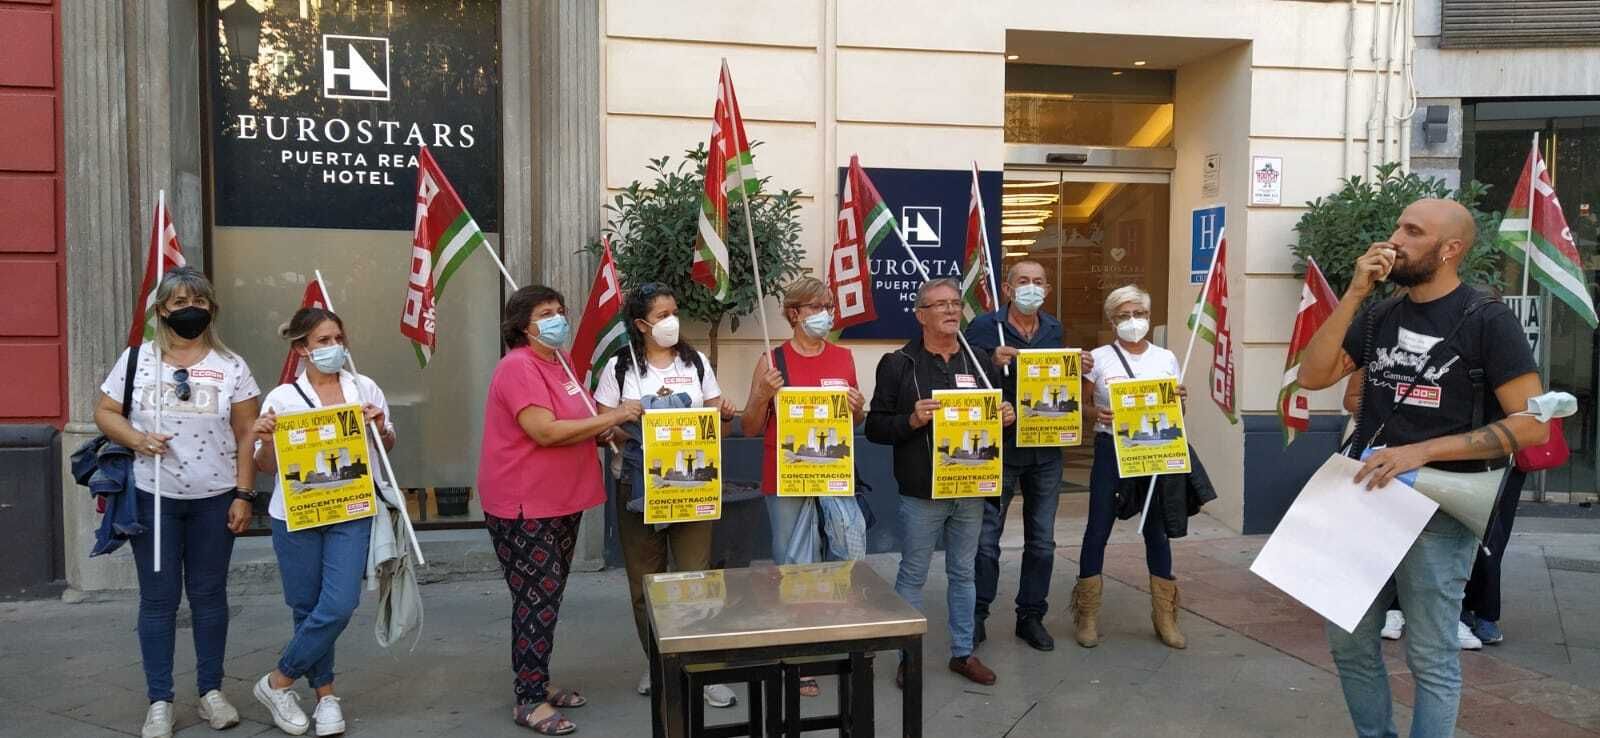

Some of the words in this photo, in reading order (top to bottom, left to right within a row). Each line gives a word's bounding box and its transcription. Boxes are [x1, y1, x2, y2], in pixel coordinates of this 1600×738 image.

[237, 115, 475, 148] EUROSTARS
[282, 150, 368, 166] PUERTA
[378, 154, 420, 168] REA
[323, 170, 394, 185] HOTEL
[1200, 214, 1216, 249] H
[870, 259, 961, 275] UROSTA
[1062, 355, 1078, 377] YA
[1159, 382, 1177, 404] YA
[831, 394, 848, 418] YA
[984, 396, 998, 420] YA
[337, 410, 361, 437] YA
[698, 415, 717, 440] YA
[289, 493, 372, 512] CONCENTRACIÓN
[648, 495, 719, 505] CONCENTRACIÓN
